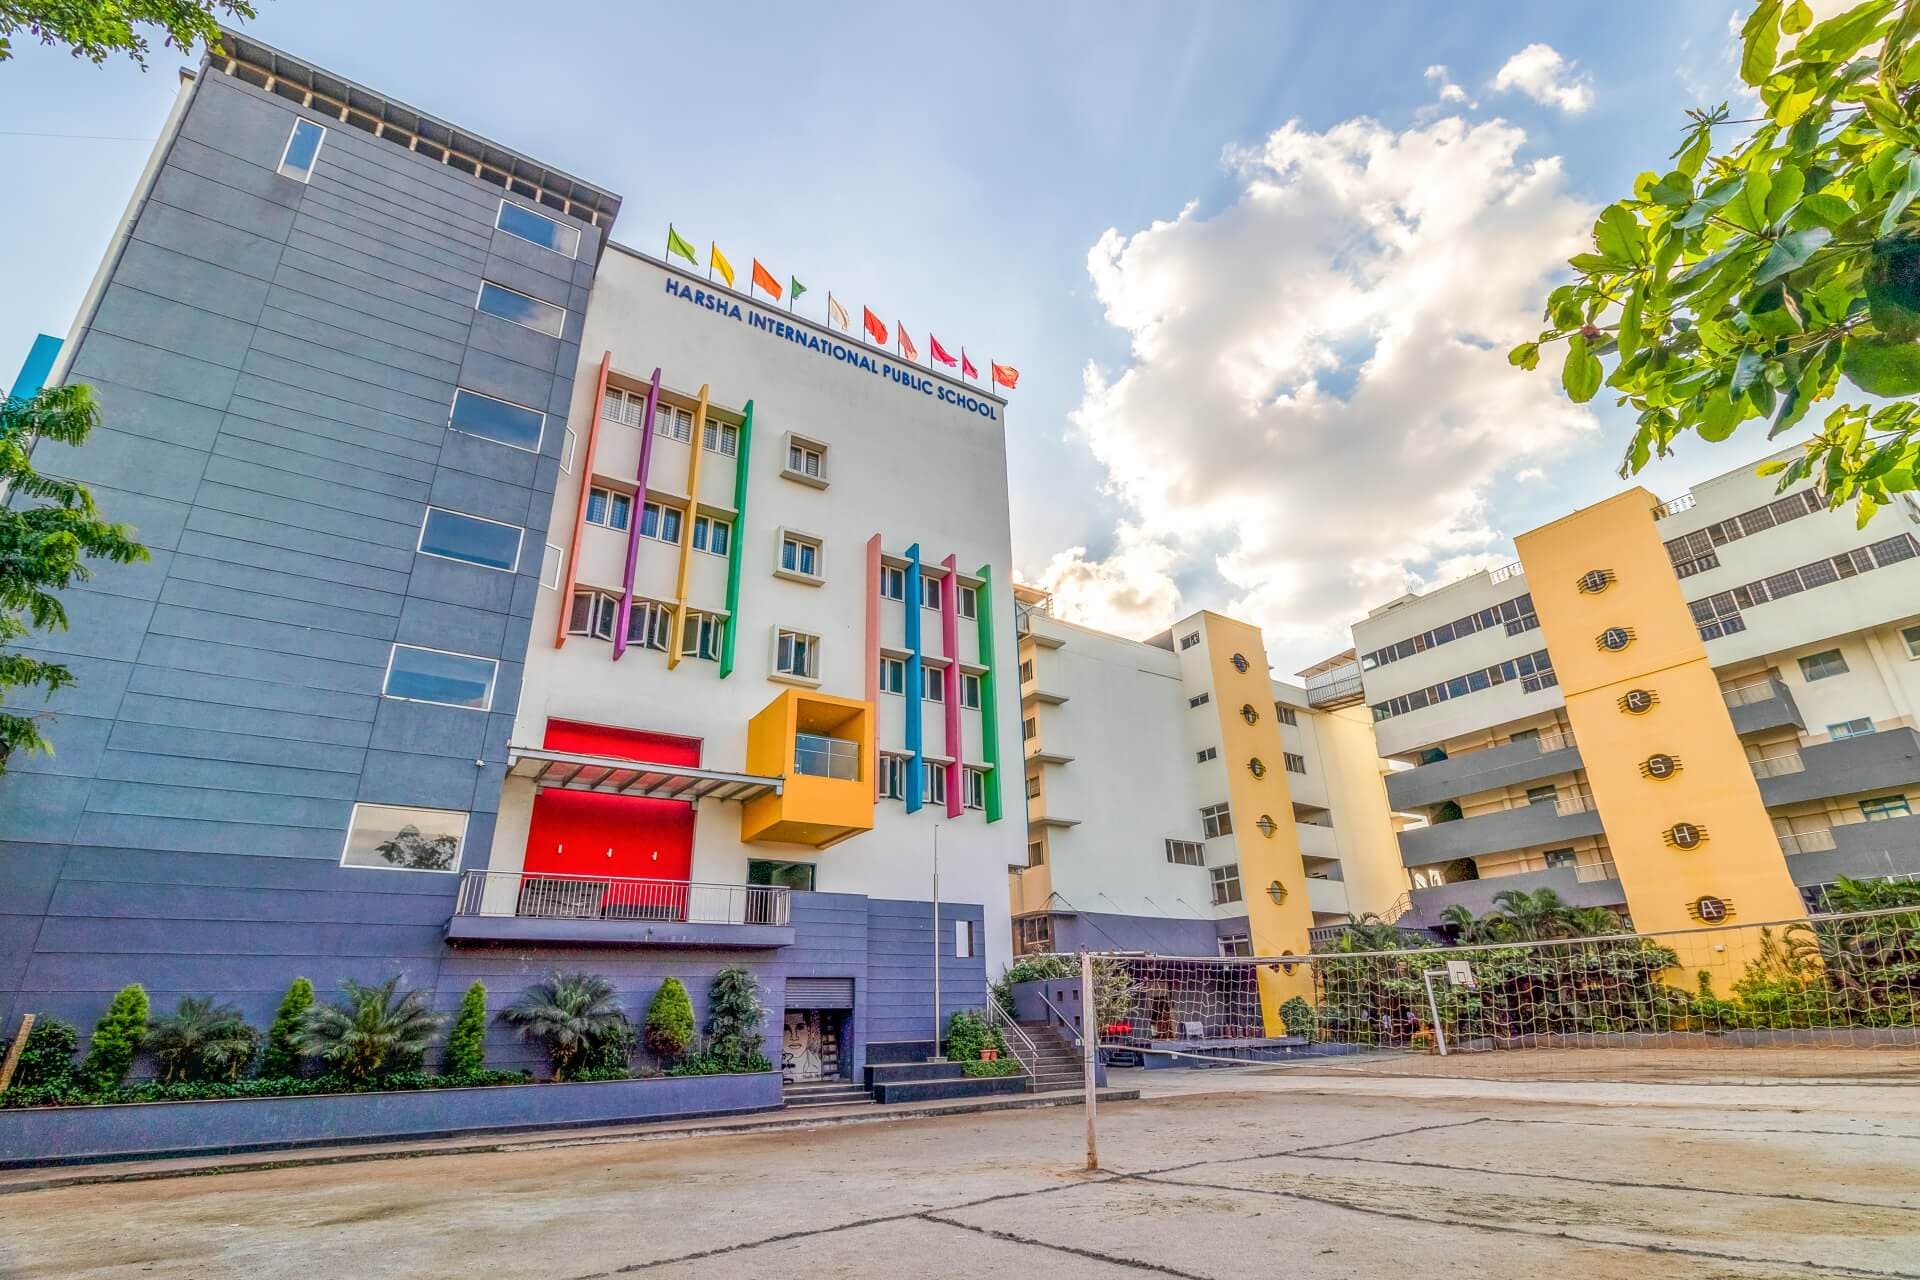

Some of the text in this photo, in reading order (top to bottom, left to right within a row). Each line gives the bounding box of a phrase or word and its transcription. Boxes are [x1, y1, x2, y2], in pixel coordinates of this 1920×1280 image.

[665, 278, 997, 420] HARSHA INTERNATIONAL PUBLIC SCHOOL
